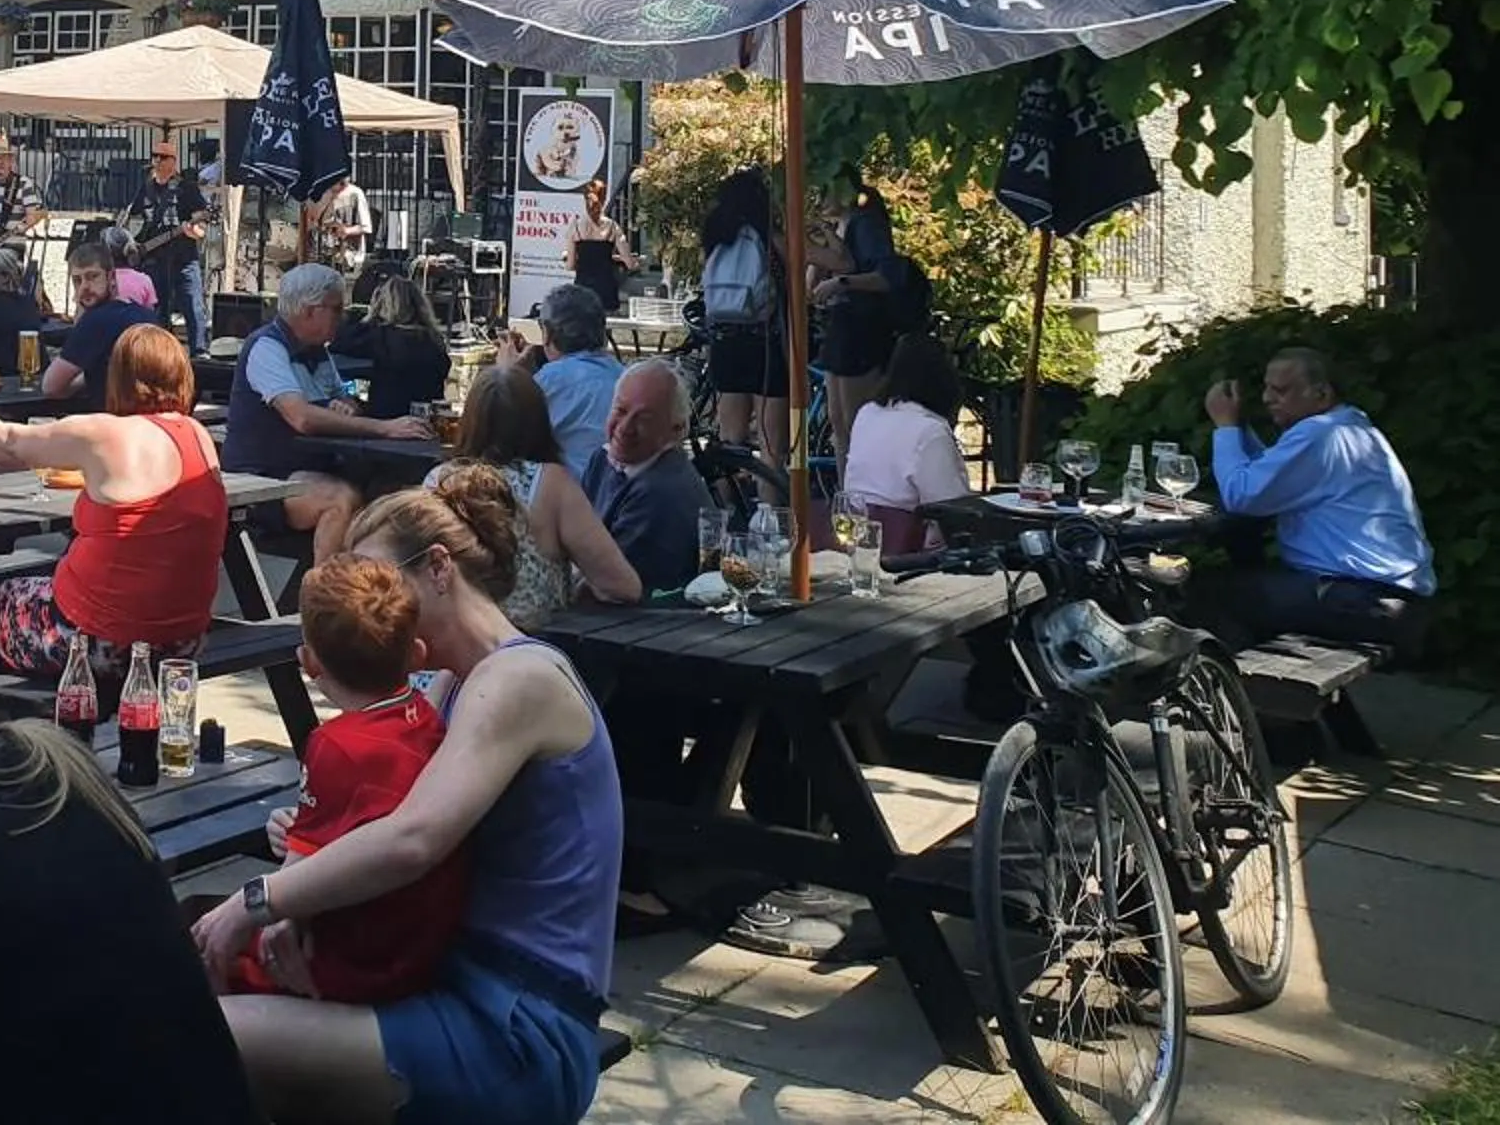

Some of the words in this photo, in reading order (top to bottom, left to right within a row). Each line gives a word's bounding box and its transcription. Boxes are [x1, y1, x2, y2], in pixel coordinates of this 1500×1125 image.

[260, 125, 296, 154] PA
[1008, 142, 1050, 180] PA
[516, 210, 572, 225] JUNKY
[516, 225, 557, 238] DOGS
